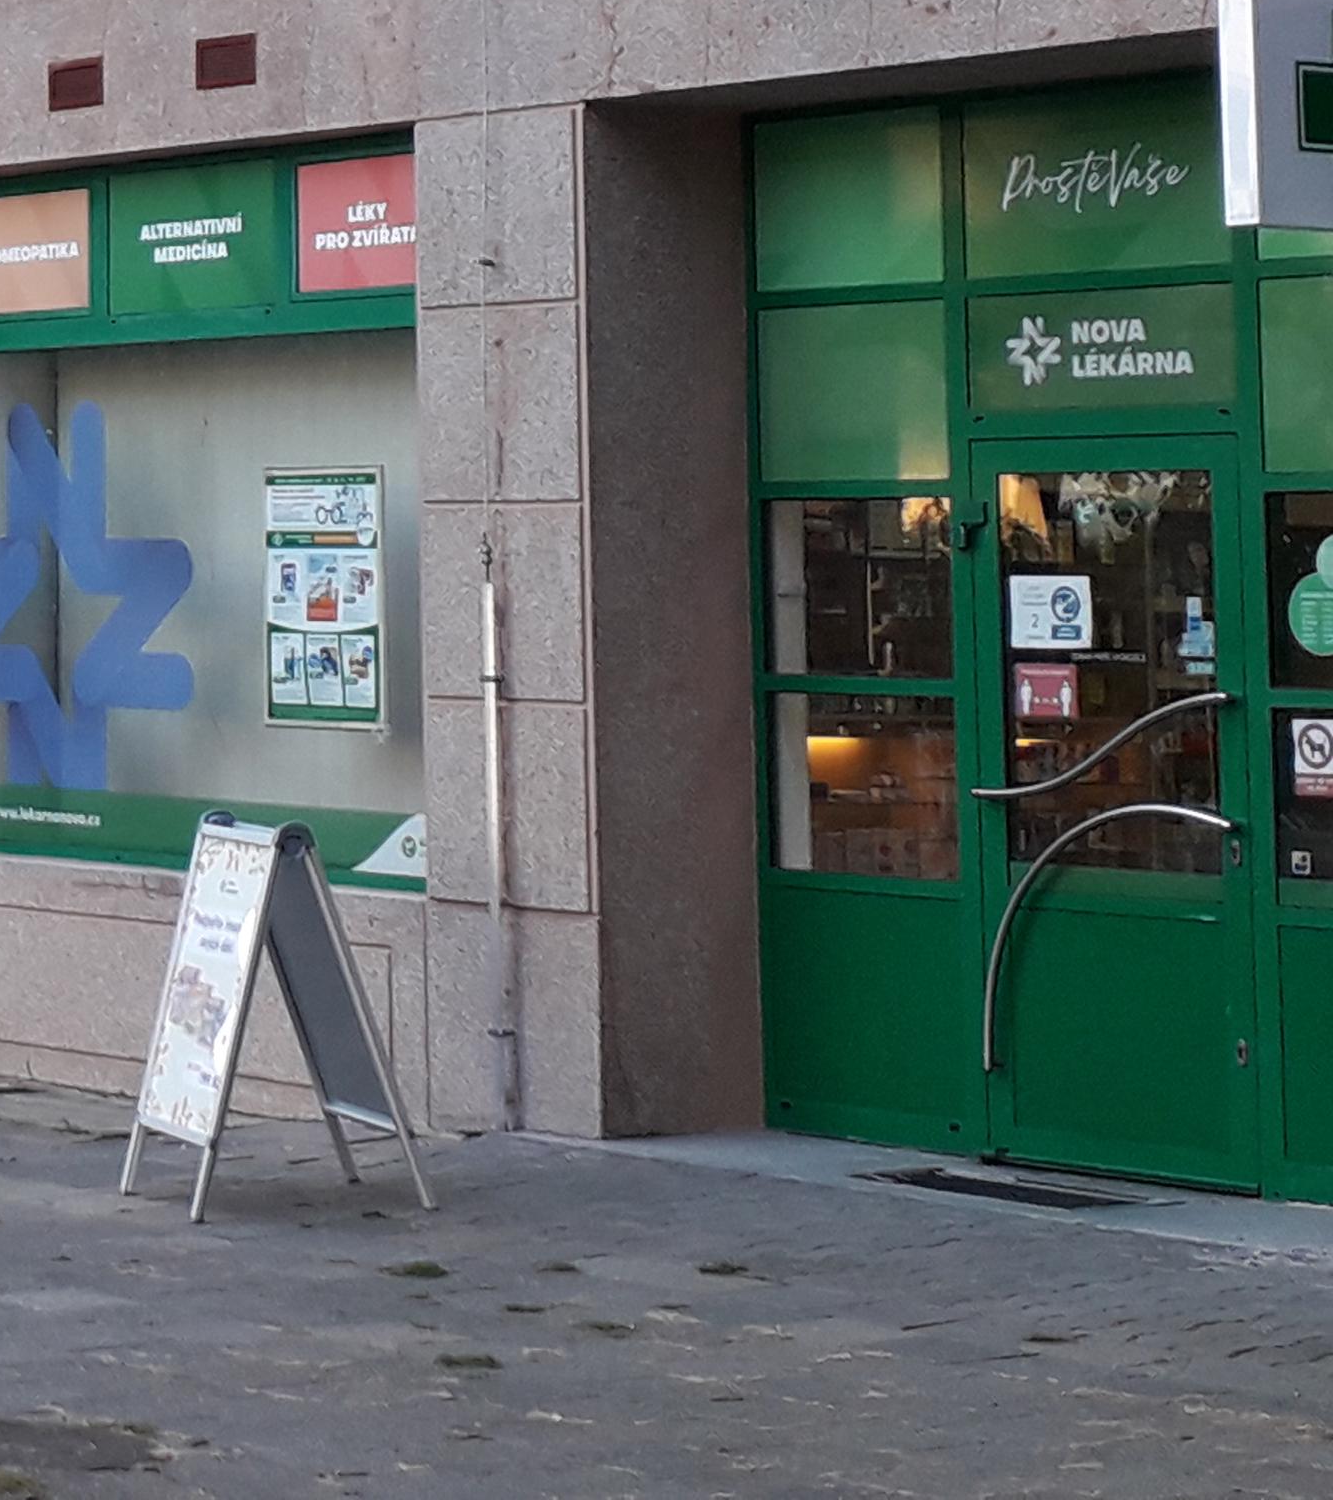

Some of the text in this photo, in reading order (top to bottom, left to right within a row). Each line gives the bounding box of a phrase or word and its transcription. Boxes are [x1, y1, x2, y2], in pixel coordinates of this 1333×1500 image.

[347, 200, 388, 223] LÉKY
[139, 211, 243, 241] ALTERNATIVNÍ
[154, 238, 229, 264] MEDICÍNA
[315, 231, 350, 251] PRO
[1070, 317, 1147, 345] NOVA
[1070, 347, 1195, 378] LÉKÁRNA
[1031, 613, 1040, 629] 2
